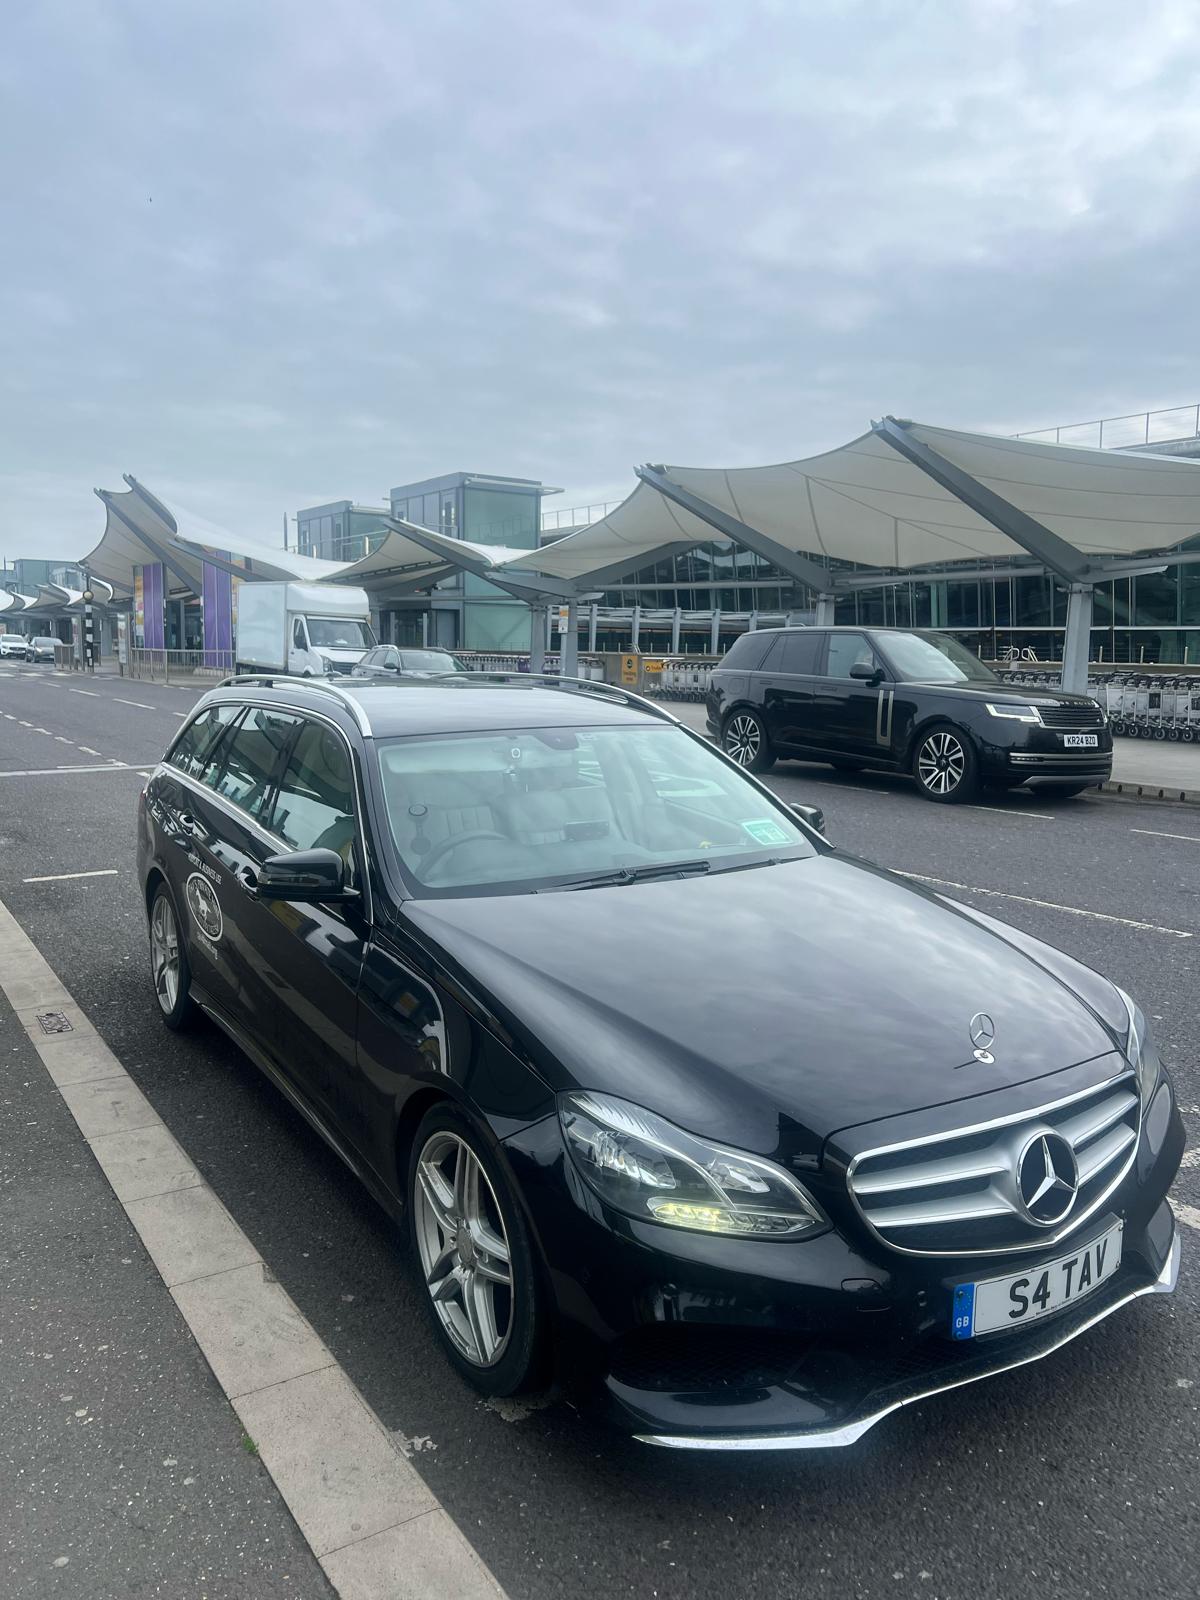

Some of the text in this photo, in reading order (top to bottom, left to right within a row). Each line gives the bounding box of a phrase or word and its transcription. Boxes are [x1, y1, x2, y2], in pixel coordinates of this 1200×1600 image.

[1067, 736, 1084, 745] KR24
[1008, 1238, 1108, 1319] S4 TAV
[955, 1315, 970, 1329] GB
